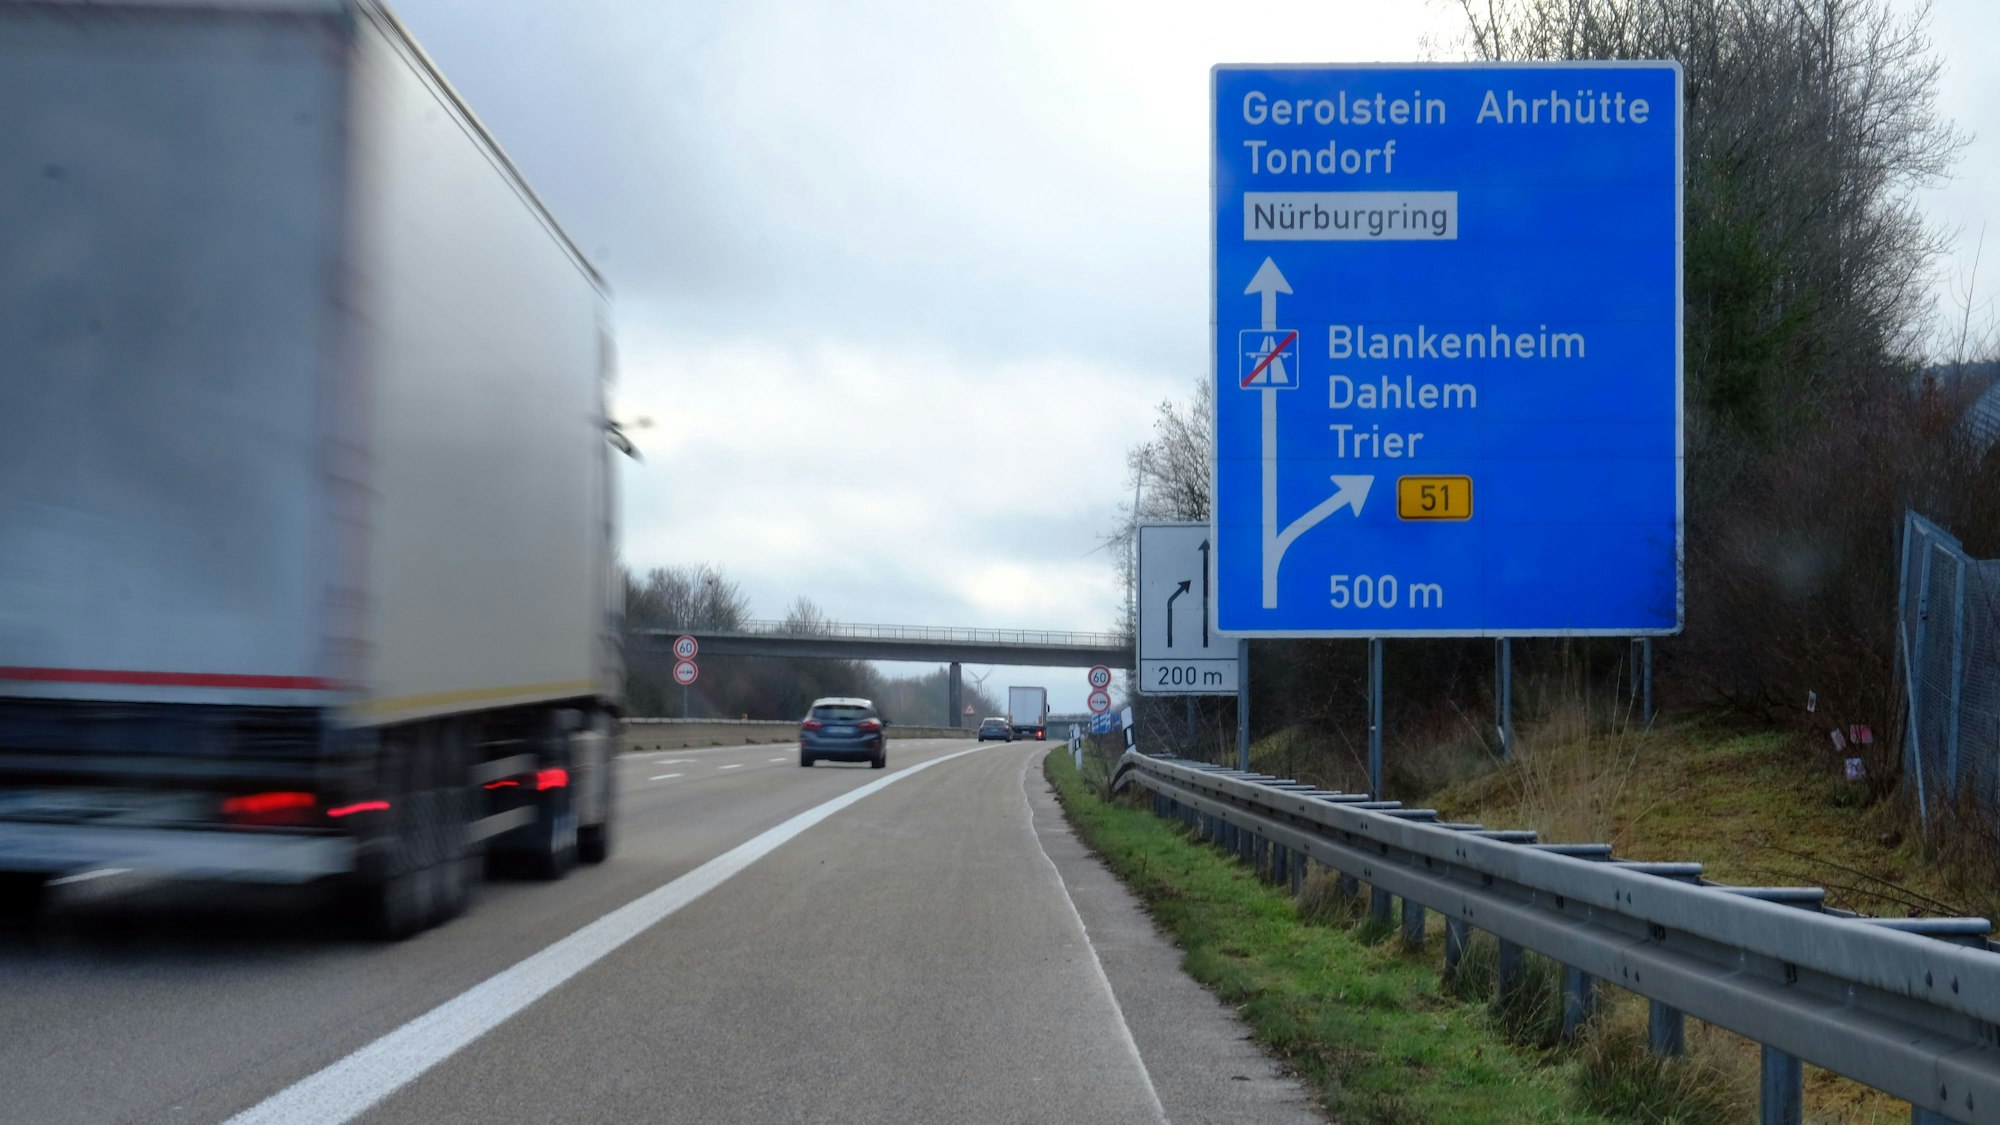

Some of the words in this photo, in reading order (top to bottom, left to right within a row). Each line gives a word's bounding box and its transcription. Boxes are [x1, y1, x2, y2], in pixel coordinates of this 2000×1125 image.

[1243, 90, 1447, 125] Gerolstein
[1476, 90, 1651, 125] Ahrhütte
[1243, 139, 1396, 175] Tondorf
[1253, 203, 1448, 236] Nürburgring
[1328, 324, 1586, 360] Blankenheim
[1328, 375, 1478, 410] Dahlem
[1329, 424, 1425, 458] Trier
[1420, 484, 1450, 512] 51
[1329, 574, 1399, 609] 500
[1409, 582, 1443, 608] m
[679, 642, 692, 653] 60
[1093, 672, 1106, 683] 60
[1158, 666, 1197, 685] 200
[1203, 671, 1222, 685] m
